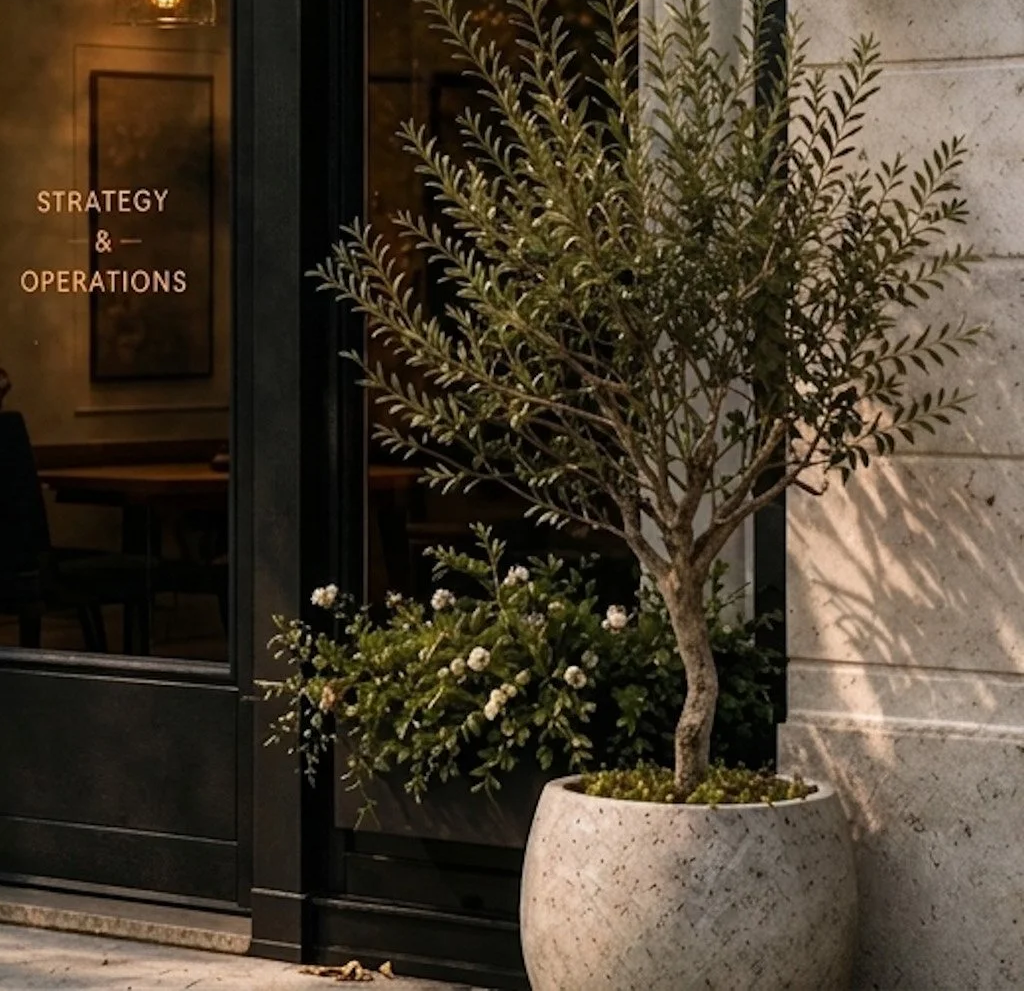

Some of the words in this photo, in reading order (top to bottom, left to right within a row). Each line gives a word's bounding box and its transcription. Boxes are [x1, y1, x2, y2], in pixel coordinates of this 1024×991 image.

[37, 188, 169, 213] STRATEGY
[95, 229, 112, 254] &
[20, 268, 187, 293] OPERATIONS
